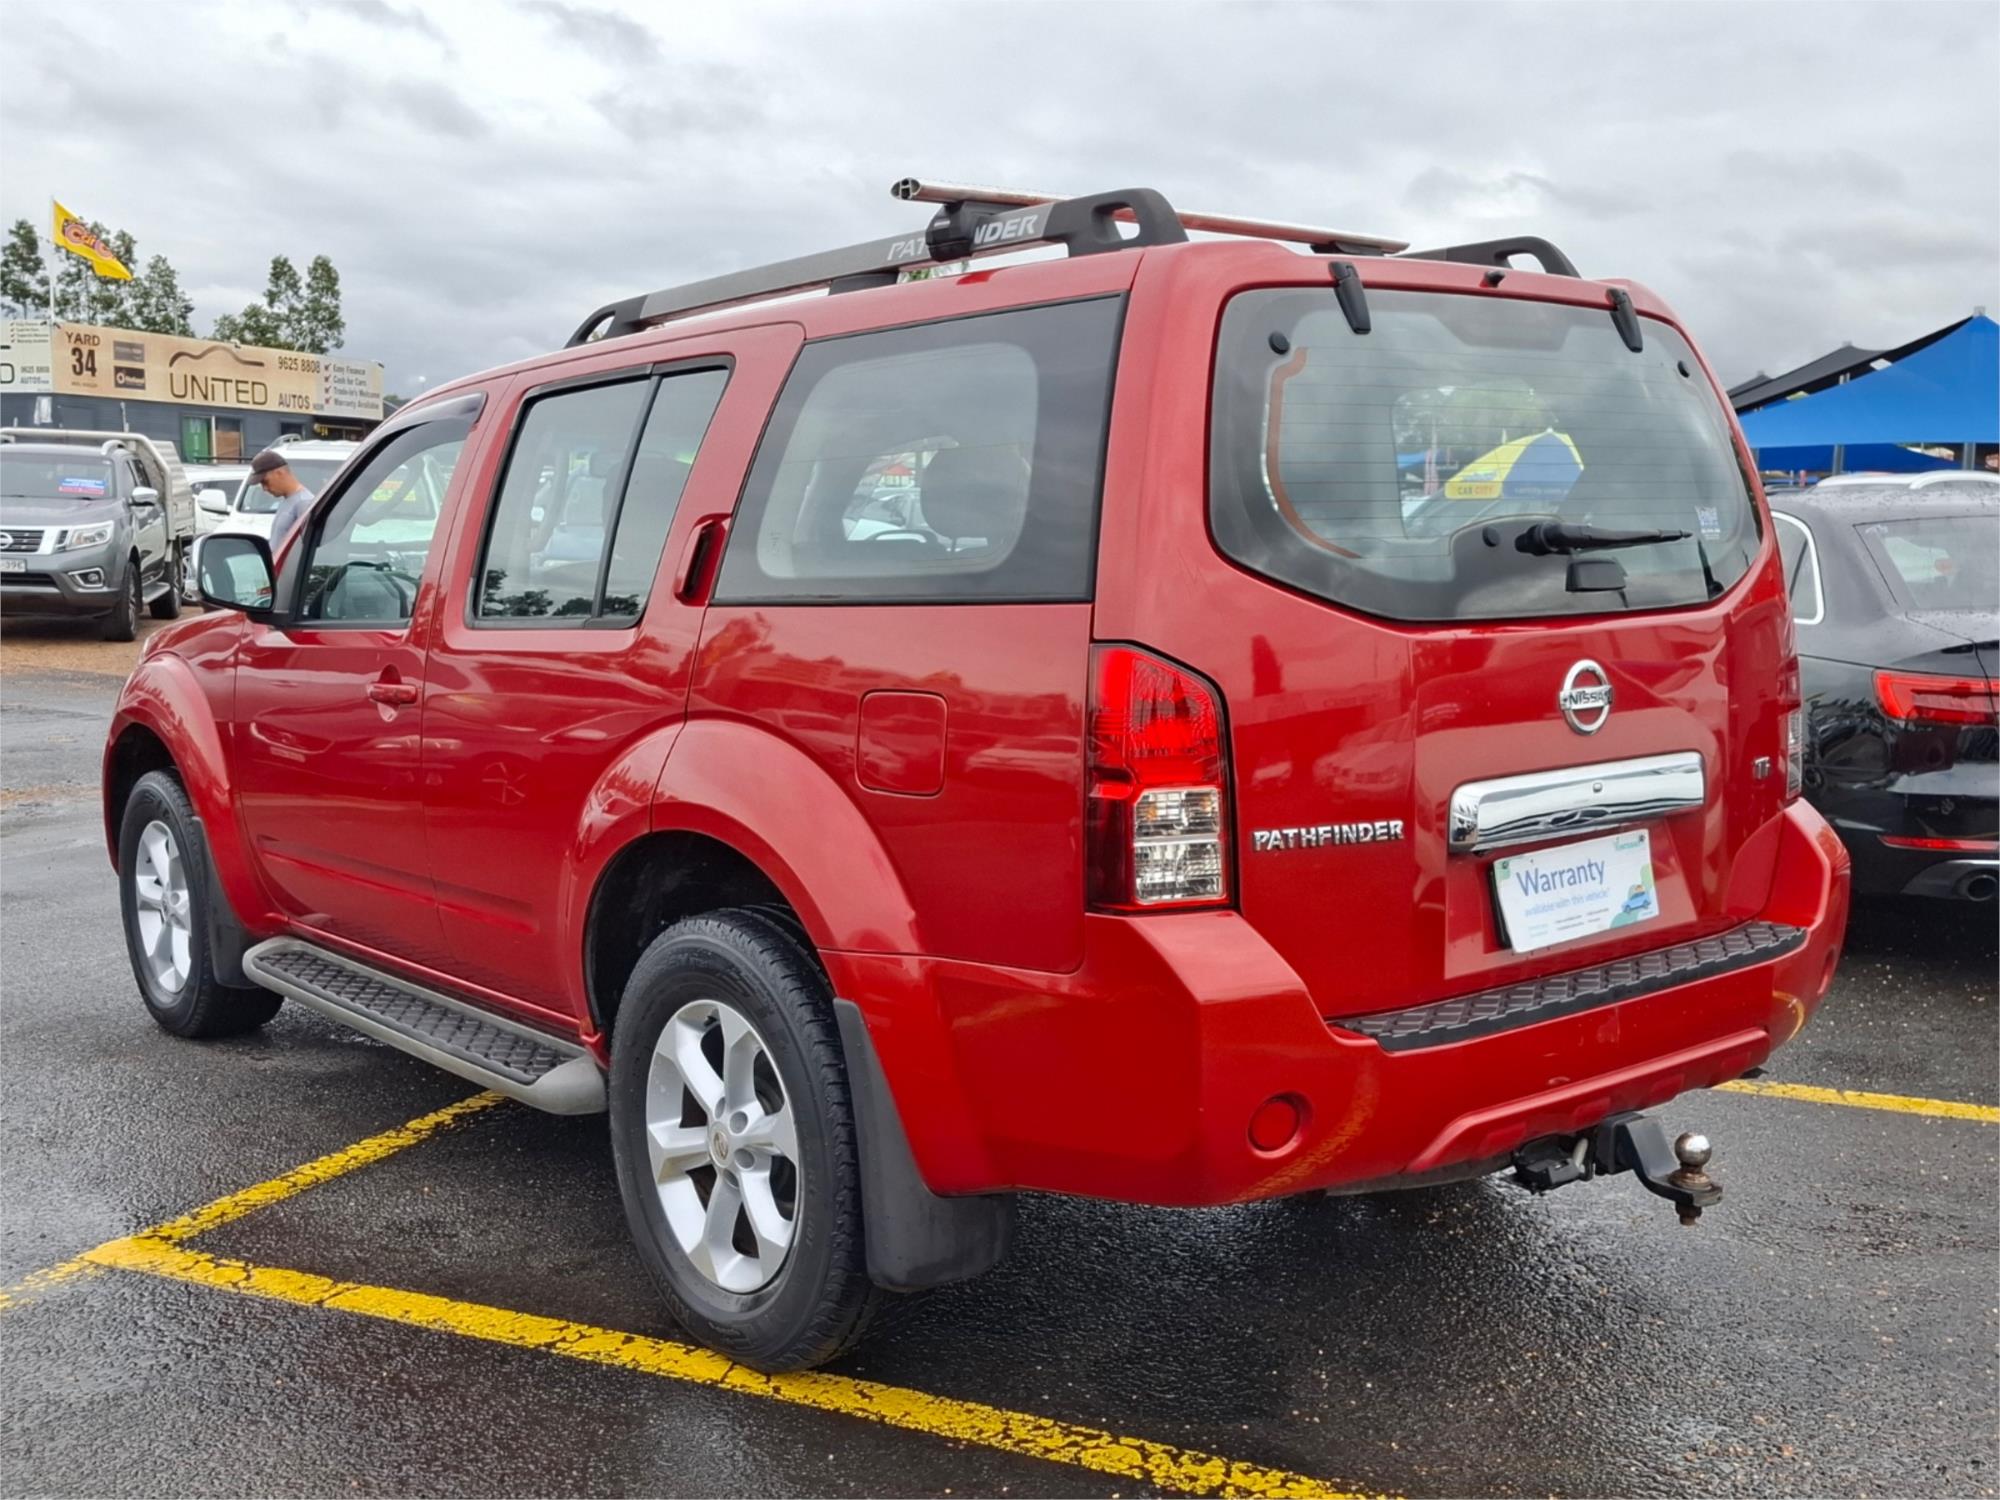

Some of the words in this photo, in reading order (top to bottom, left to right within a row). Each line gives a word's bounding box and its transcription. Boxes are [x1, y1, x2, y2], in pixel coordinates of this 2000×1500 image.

[66, 331, 101, 347] YARD
[71, 347, 97, 377] 34
[278, 356, 299, 371] 9625
[301, 359, 321, 374] 8808
[333, 363, 345, 375] Easy
[278, 392, 311, 410] AUTOS
[1253, 820, 1405, 851] PATHFINDER
[1516, 858, 1605, 896] Warranty
